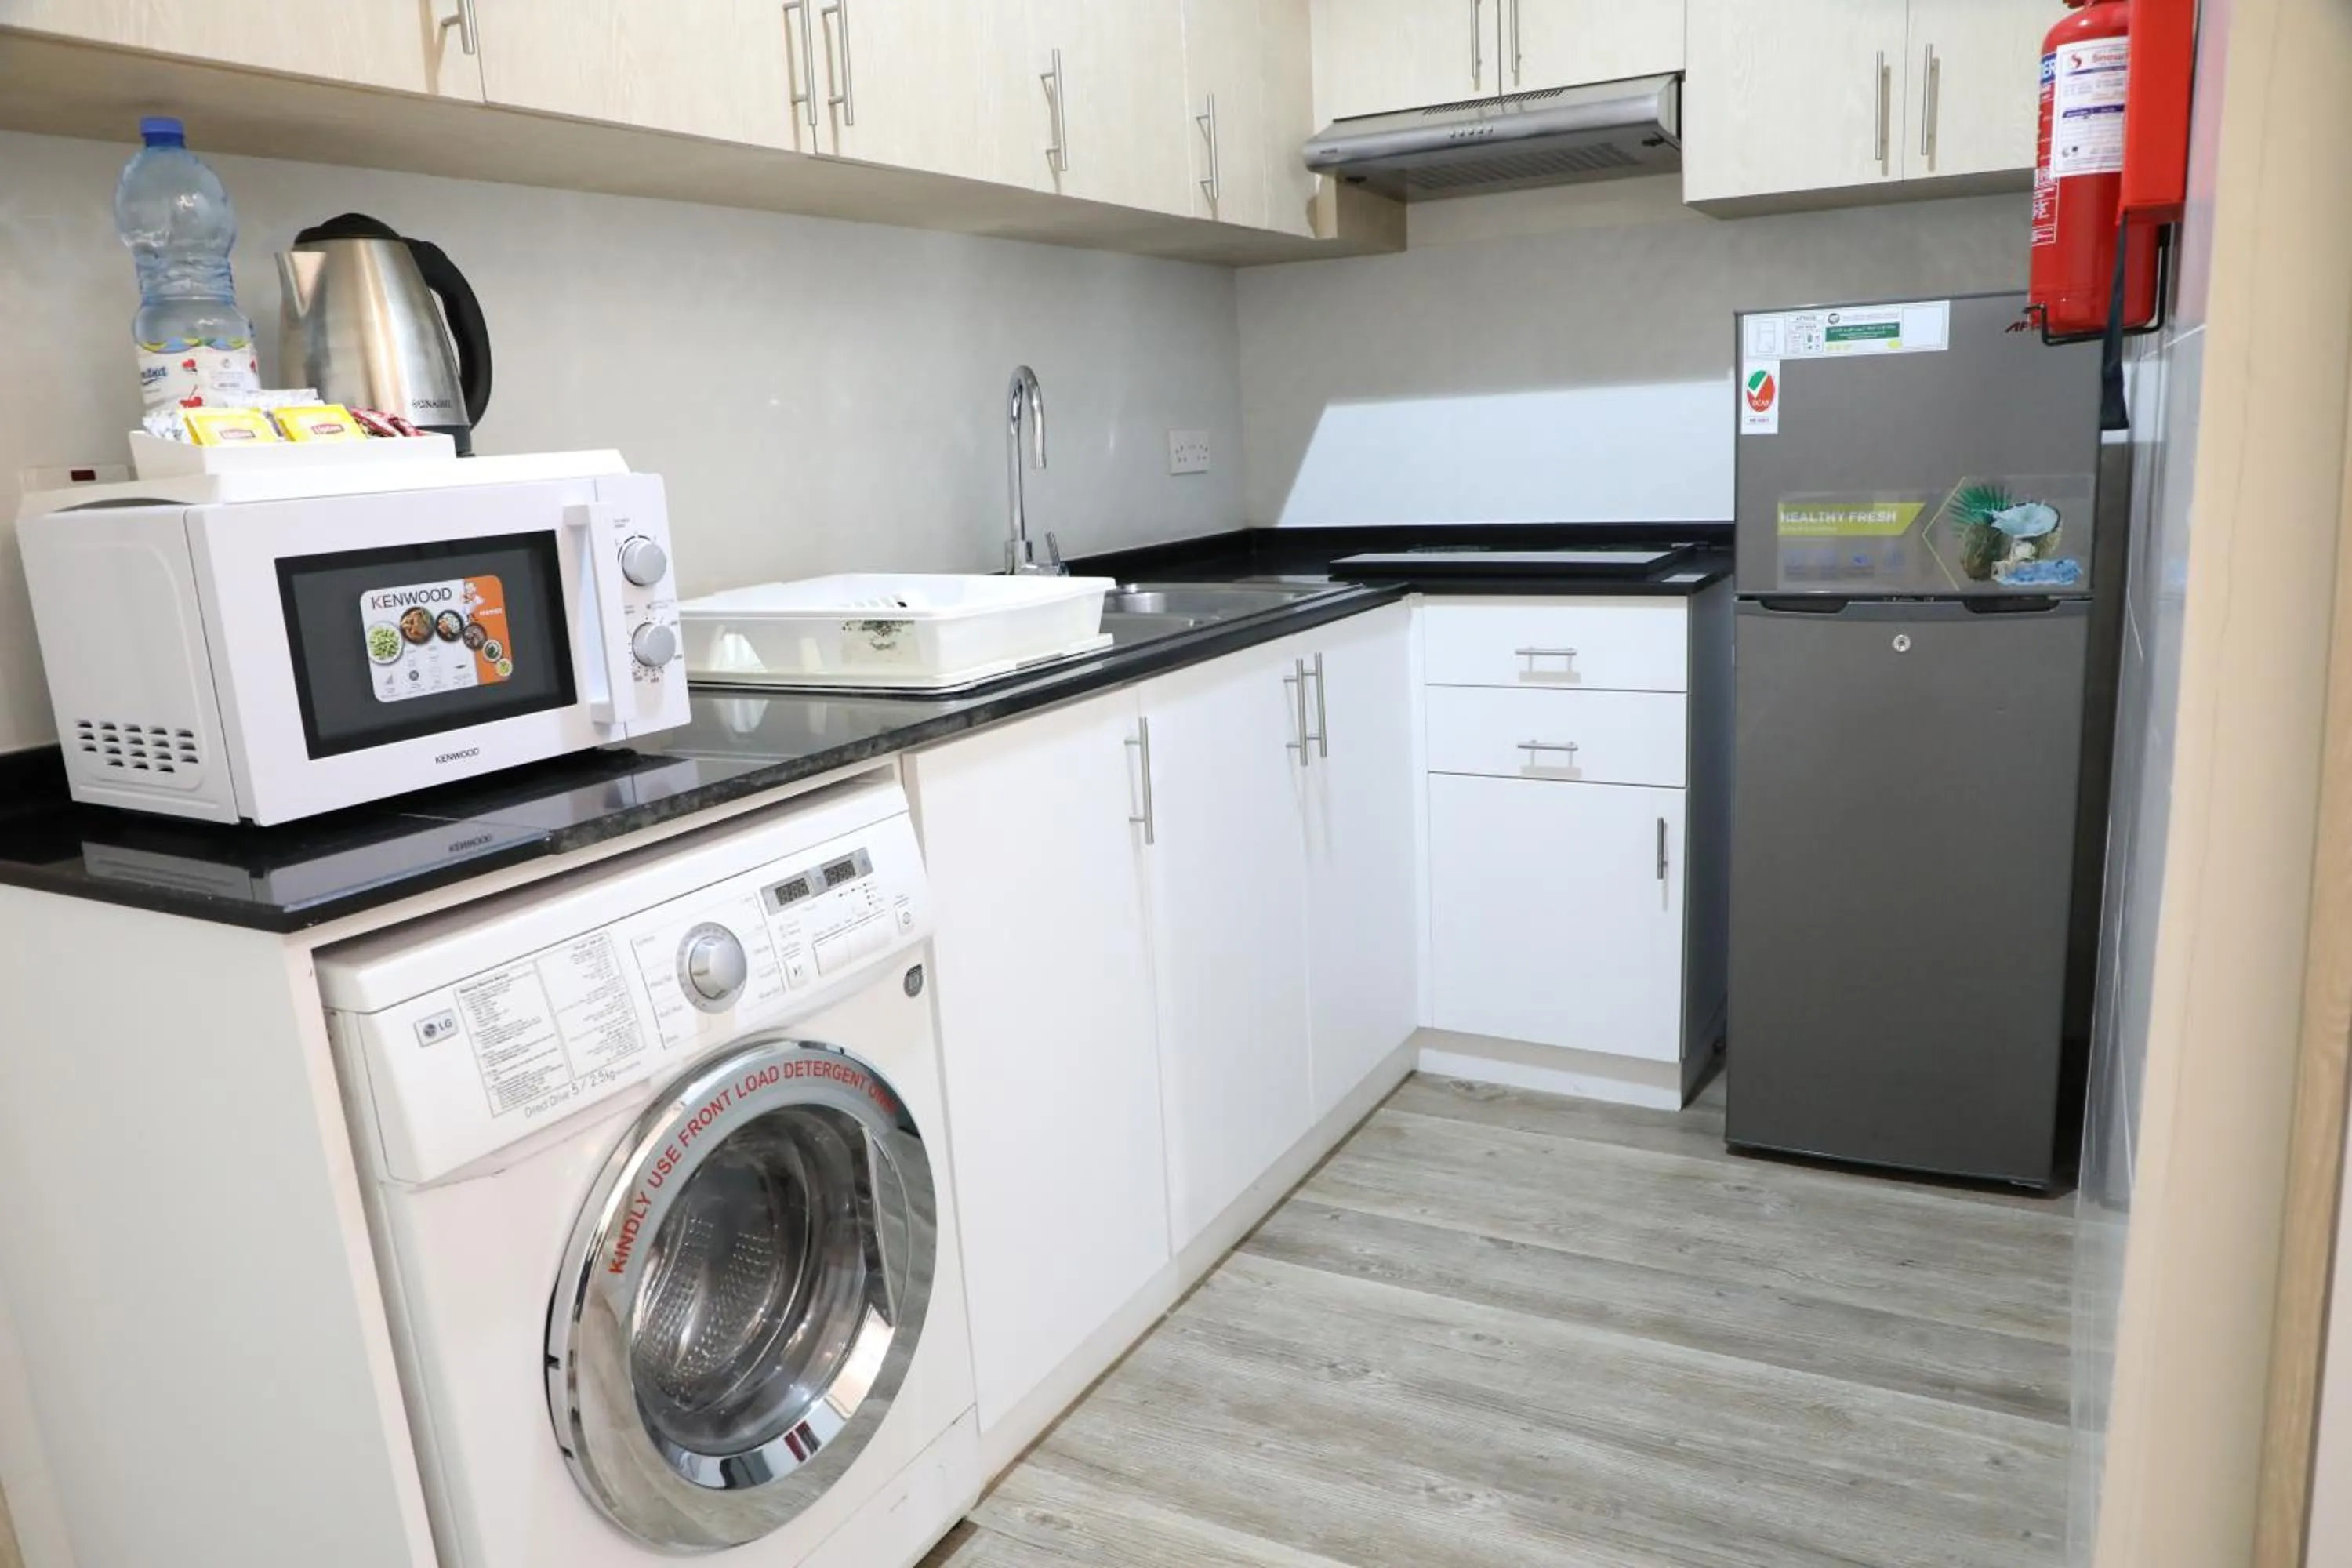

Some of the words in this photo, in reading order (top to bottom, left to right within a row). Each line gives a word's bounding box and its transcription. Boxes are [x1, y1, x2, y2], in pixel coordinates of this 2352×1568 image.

[1780, 511, 1845, 524] HEALTHY
[1849, 510, 1896, 523] FRESH
[371, 587, 452, 609] KENWOOD
[435, 746, 479, 764] KENWOOD
[438, 1018, 452, 1031] LG
[608, 1191, 652, 1275] KINDLY
[647, 1144, 682, 1189] USE
[677, 1091, 732, 1148] FRONT
[735, 1065, 779, 1099] LOAD
[783, 1060, 869, 1090] DETERGENT
